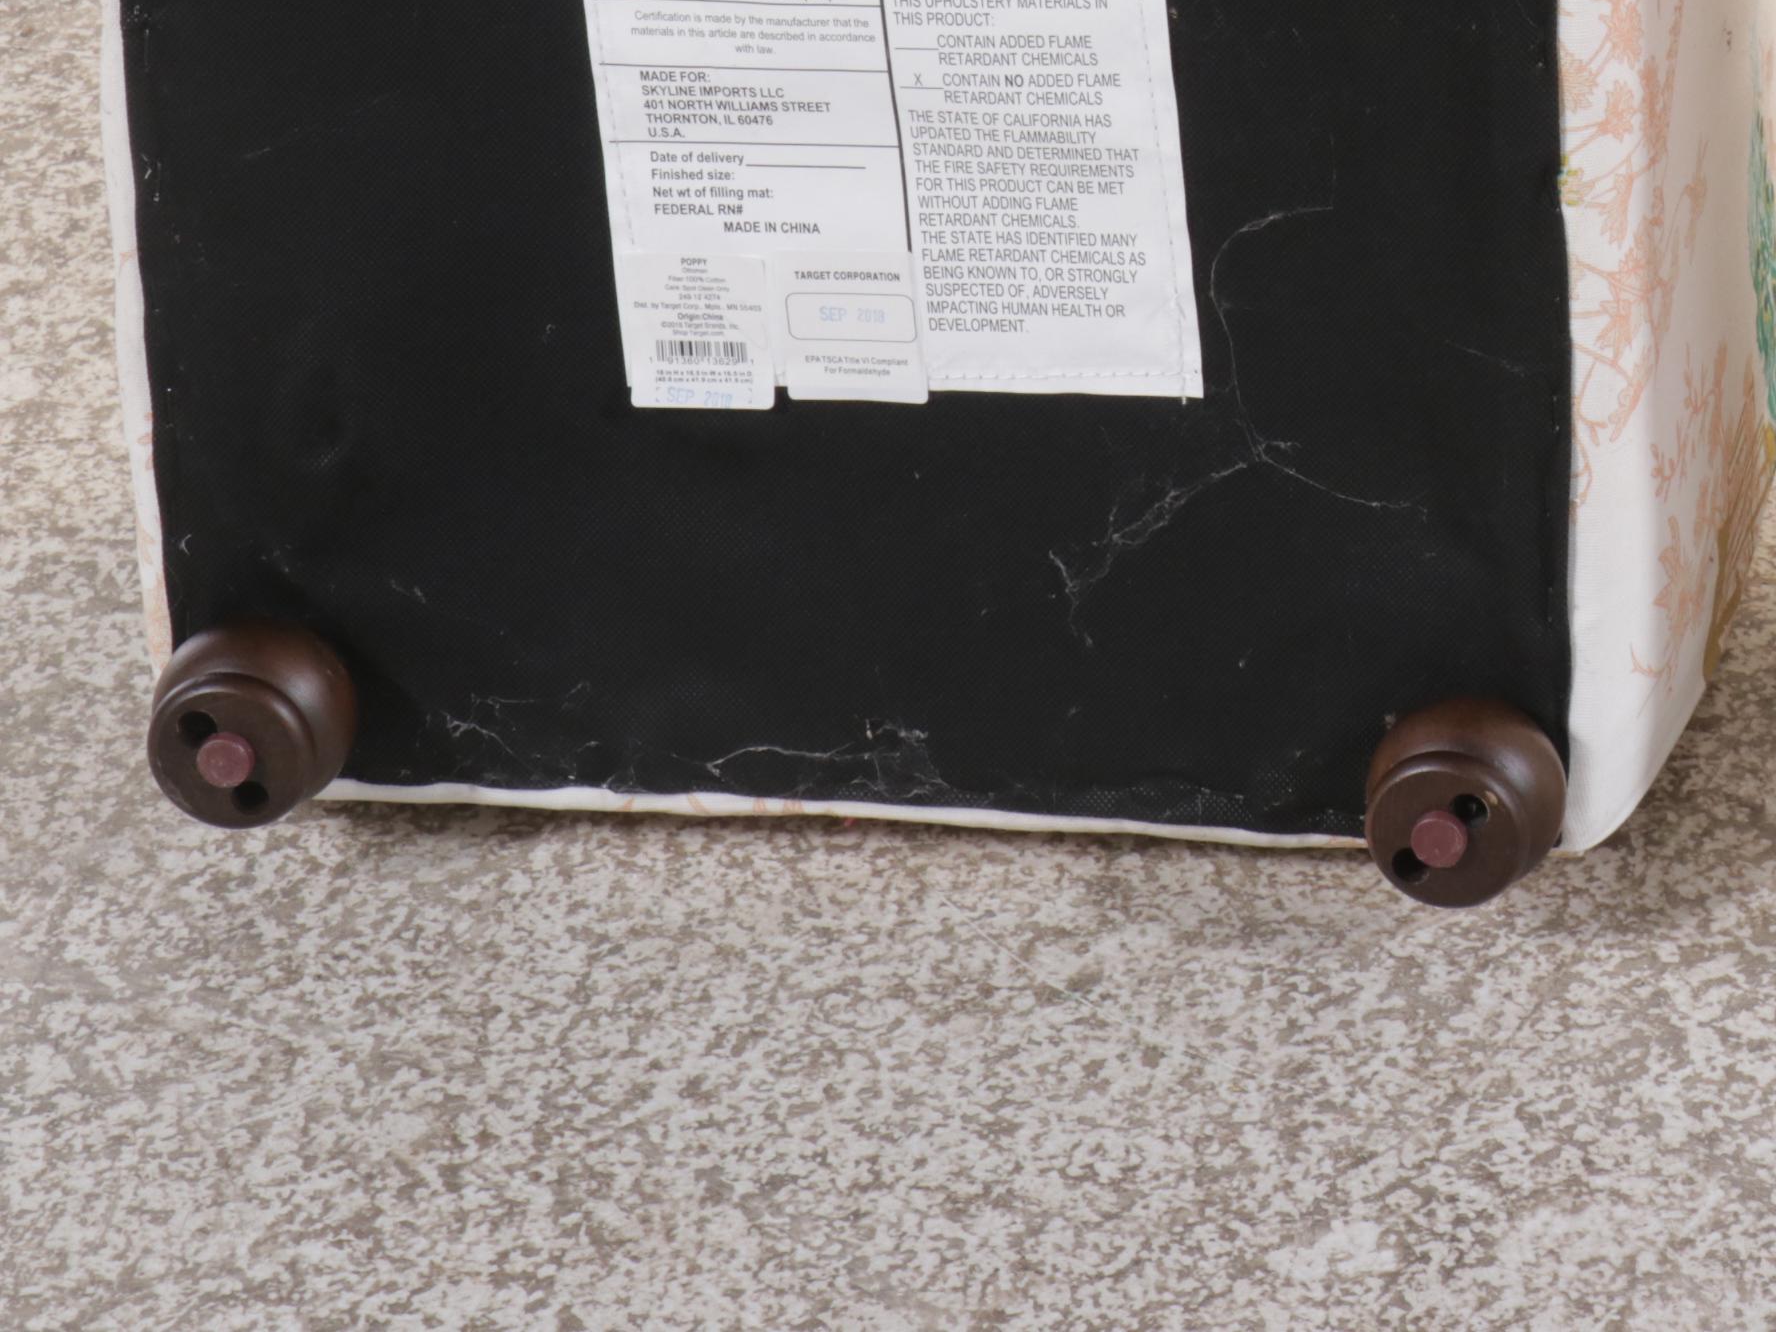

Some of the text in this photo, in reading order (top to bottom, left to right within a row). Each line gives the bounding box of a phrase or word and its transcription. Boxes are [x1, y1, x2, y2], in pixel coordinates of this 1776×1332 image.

[640, 70, 710, 82] MADE FOR:
[642, 85, 784, 98] SKYLINE IMPORTS LLC
[644, 99, 830, 112] 401 NORTH WILLIAMS STREET
[645, 113, 773, 125] THORNTON, IL 60476
[648, 127, 685, 138] U.S.A.
[650, 151, 744, 165] Date of delivery
[651, 168, 734, 180] Finished size:
[652, 186, 773, 201] Net wt of filling mat:
[654, 203, 743, 215] FEDERAL RN#
[723, 221, 820, 234] MADE IN CHINA
[794, 271, 900, 282] TARGET CORPORATION
